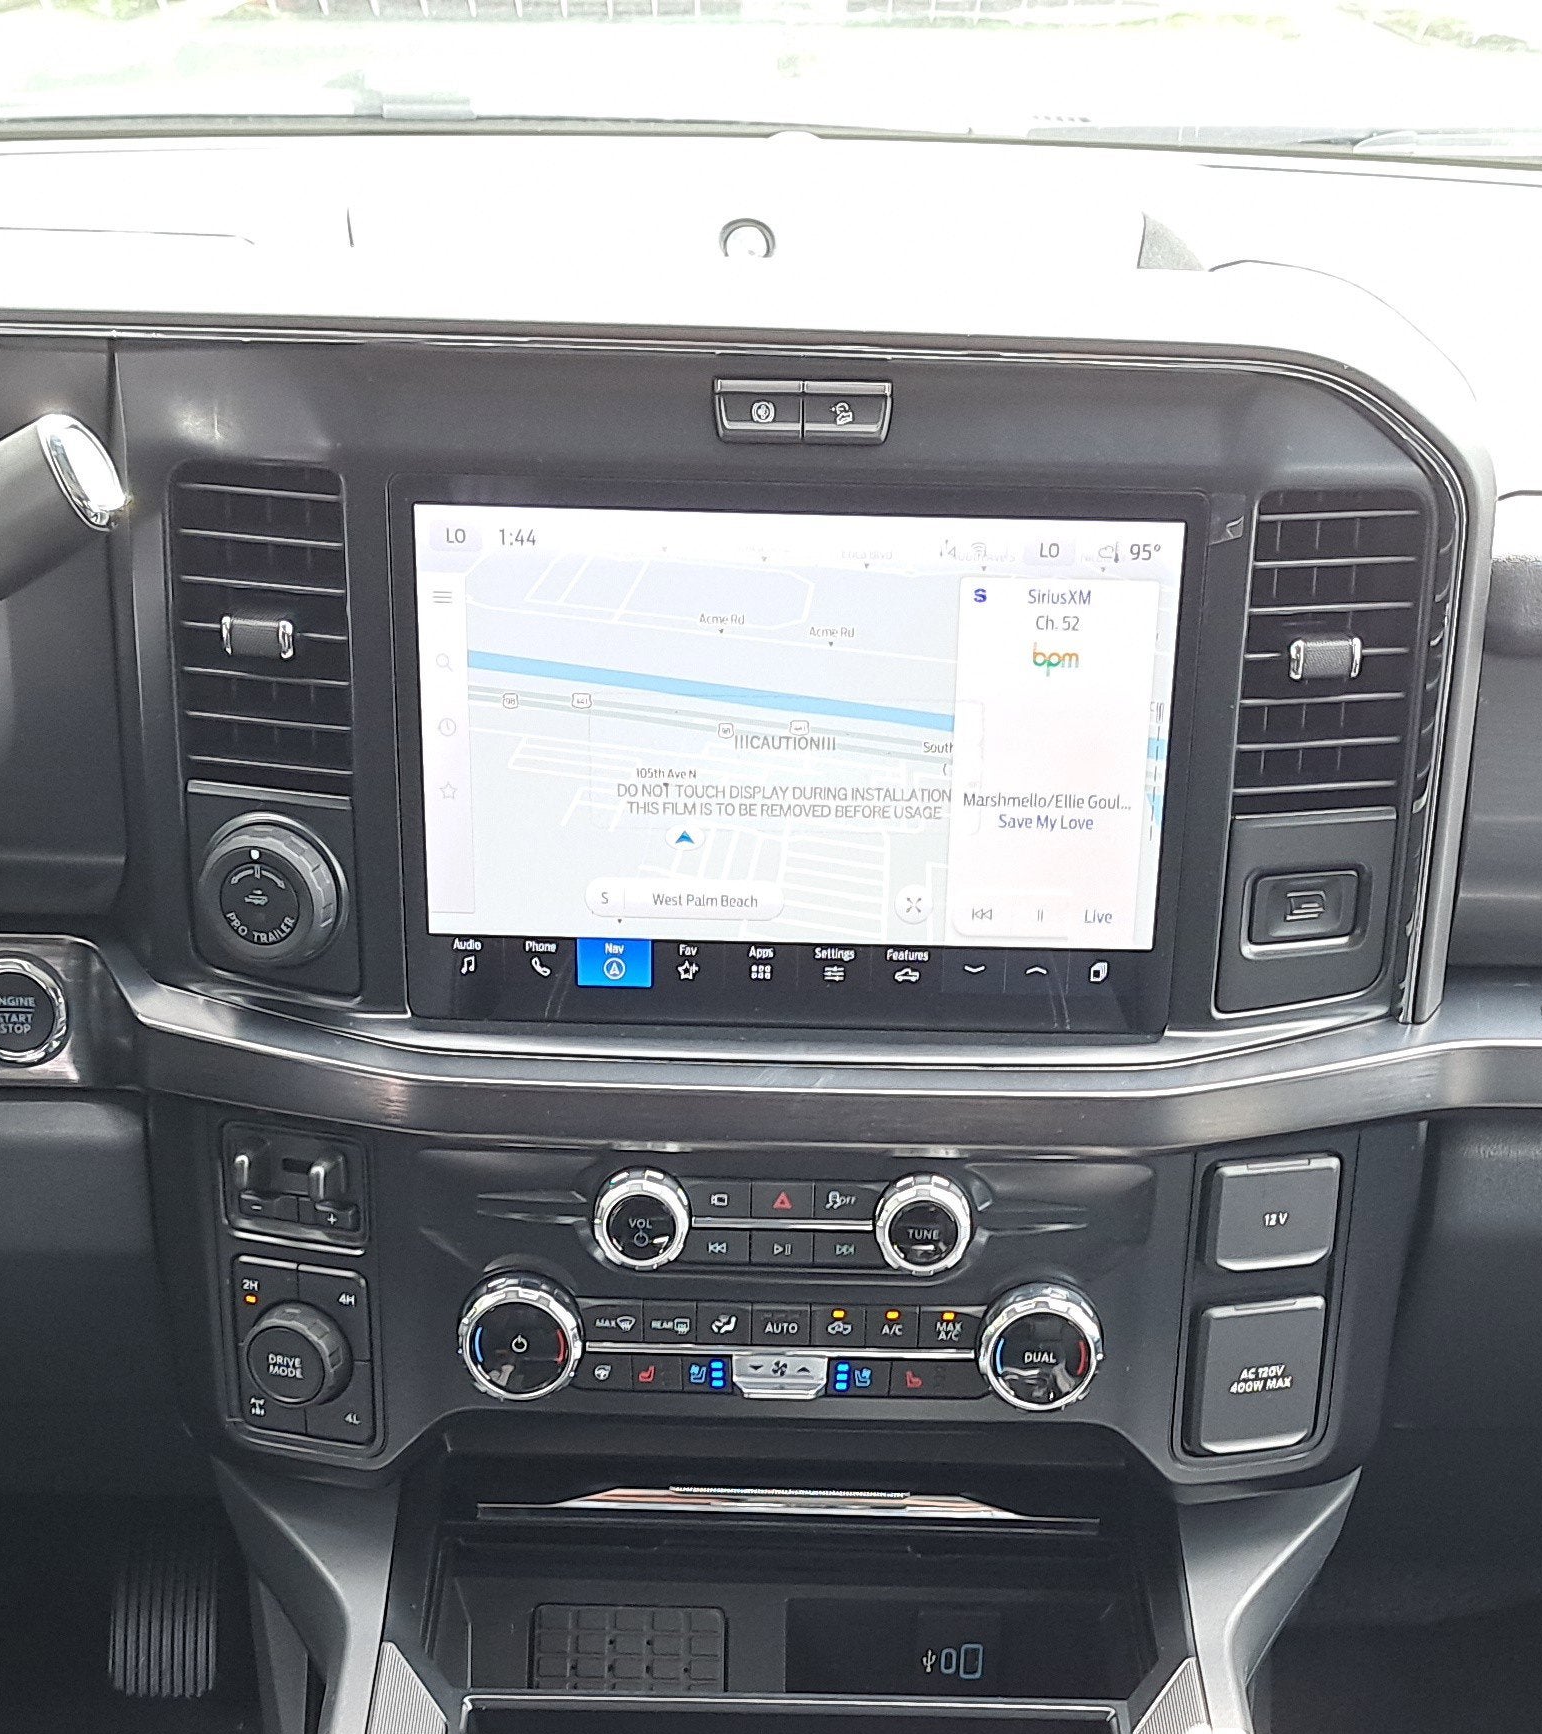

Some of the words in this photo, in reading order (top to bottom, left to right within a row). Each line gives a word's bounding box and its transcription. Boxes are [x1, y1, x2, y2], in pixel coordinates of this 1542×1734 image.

[446, 527, 467, 544] LO
[498, 528, 538, 546] 1:44
[1038, 541, 1060, 559] LO
[1027, 588, 1093, 606] SiriusXM
[1035, 615, 1058, 631] Ch.
[1062, 616, 1080, 631] 52
[1032, 641, 1080, 677] bpm
[616, 783, 639, 798] DO
[641, 783, 670, 799] NOT
[676, 783, 725, 800] TOUCH
[728, 785, 791, 800] DISPLAY
[792, 786, 848, 801] DURING
[850, 787, 952, 802] INSTALLATION
[627, 801, 660, 815] THIS
[662, 801, 697, 816] FILM
[699, 802, 713, 816] IS
[716, 802, 736, 817] TO
[738, 803, 758, 817] BE
[760, 803, 832, 819] REMOVED
[834, 804, 891, 819] BEFORE
[893, 805, 943, 820] USAGE
[998, 813, 1033, 829] Save
[1036, 814, 1057, 832] My
[1060, 815, 1095, 830] Love
[652, 891, 684, 906] West
[685, 891, 718, 907] Palm
[719, 893, 759, 908] Beach
[1084, 908, 1113, 924] Live
[225, 910, 249, 937] PRO
[251, 914, 297, 945] TRAILER
[452, 937, 483, 951] Audio
[525, 939, 558, 953] Phone
[605, 942, 626, 955] Nav
[679, 943, 699, 956] Fav
[749, 946, 775, 960] Apps
[814, 946, 856, 962] Settings
[886, 948, 930, 961] Features
[0, 1023, 32, 1035] STOP
[628, 1217, 654, 1231] VOL
[1278, 1212, 1289, 1226] V
[906, 1228, 941, 1242] TUNE
[242, 1279, 259, 1291] 2H
[338, 1293, 355, 1305] 4H
[594, 1318, 617, 1329] MAX
[764, 1321, 799, 1335] AUTO
[880, 1323, 904, 1337] A/C
[935, 1321, 962, 1333] MAX
[936, 1330, 961, 1343] A/C
[268, 1353, 302, 1367] DRIVE
[1023, 1351, 1057, 1365] DUAL
[269, 1365, 304, 1379] MODE
[1240, 1366, 1257, 1380] AC
[1257, 1364, 1286, 1379] 120V
[1229, 1379, 1265, 1394] 400W
[1266, 1375, 1293, 1390] MAX
[344, 1413, 360, 1424] 4L
